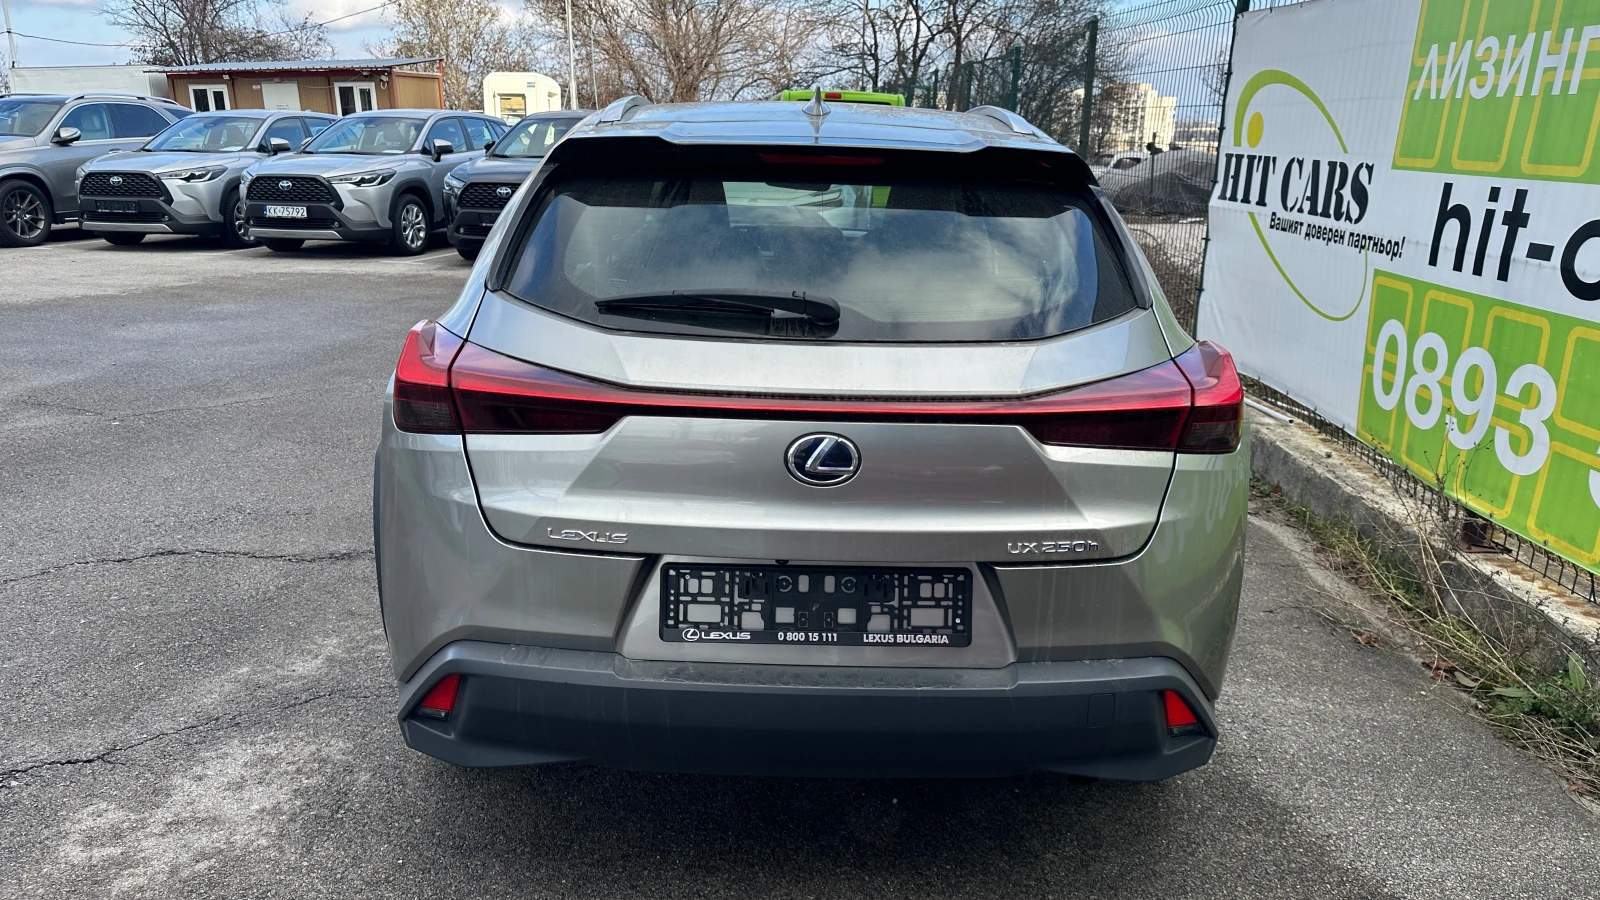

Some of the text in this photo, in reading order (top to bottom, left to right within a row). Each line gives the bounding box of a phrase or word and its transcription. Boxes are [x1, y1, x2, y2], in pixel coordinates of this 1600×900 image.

[1412, 24, 1600, 101] ЛИЗИНГ
[1217, 152, 1375, 225] HIT CARS
[1269, 211, 1406, 262] Вашият доверен партньор!
[1372, 318, 1558, 476] 0893
[547, 527, 628, 544] LEXUS
[1007, 540, 1099, 554] UX 250h
[701, 631, 751, 640] LEXUS
[777, 631, 838, 643] 0 800 15 111
[863, 633, 949, 644] LEXUS BULGARIA
